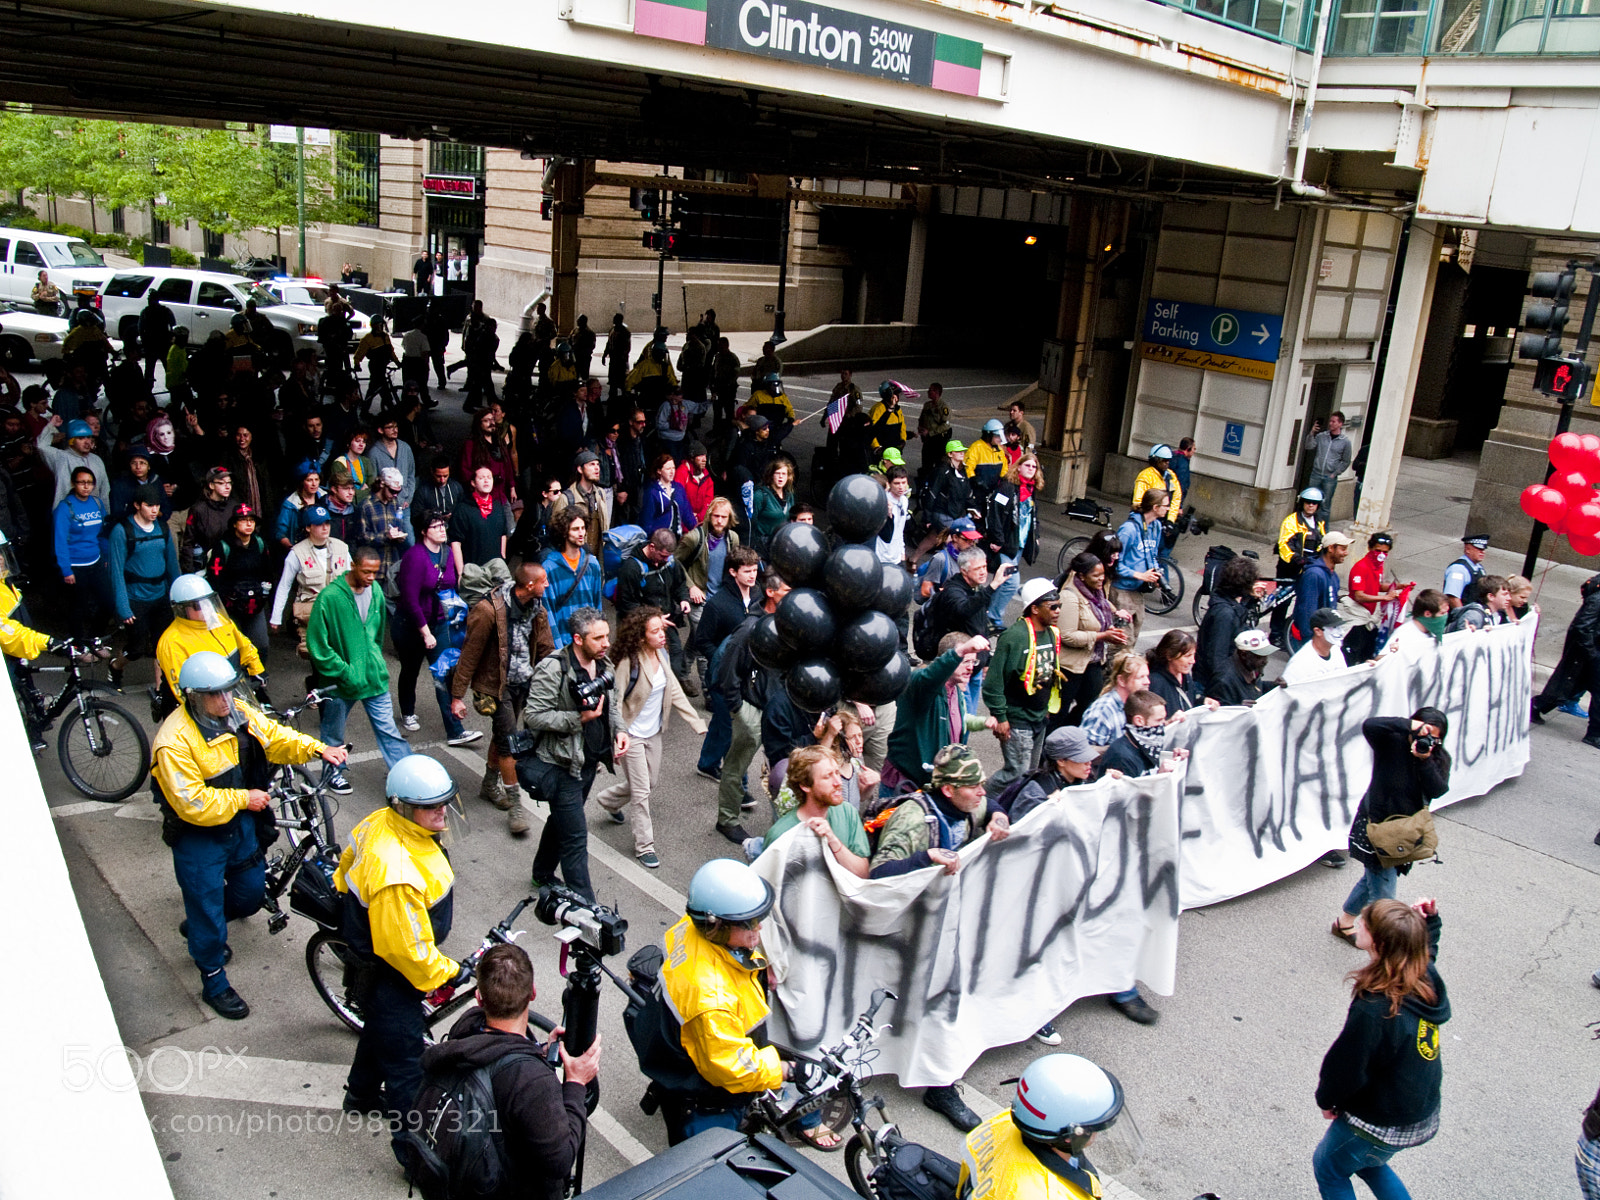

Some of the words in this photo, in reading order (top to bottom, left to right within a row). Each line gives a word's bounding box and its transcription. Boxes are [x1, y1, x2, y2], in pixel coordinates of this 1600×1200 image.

[738, 0, 862, 65] Clinton
[869, 25, 913, 54] 540W
[871, 50, 911, 74] 200N
[1154, 302, 1180, 320] Self
[1151, 321, 1199, 346] Parking
[1218, 317, 1233, 342] P
[1238, 366, 1269, 376] PARKING
[1245, 677, 1382, 859] WAR
[405, 901, 429, 960] CPD
[780, 834, 1031, 1053] SHUT
[796, 1090, 833, 1117] TREK
